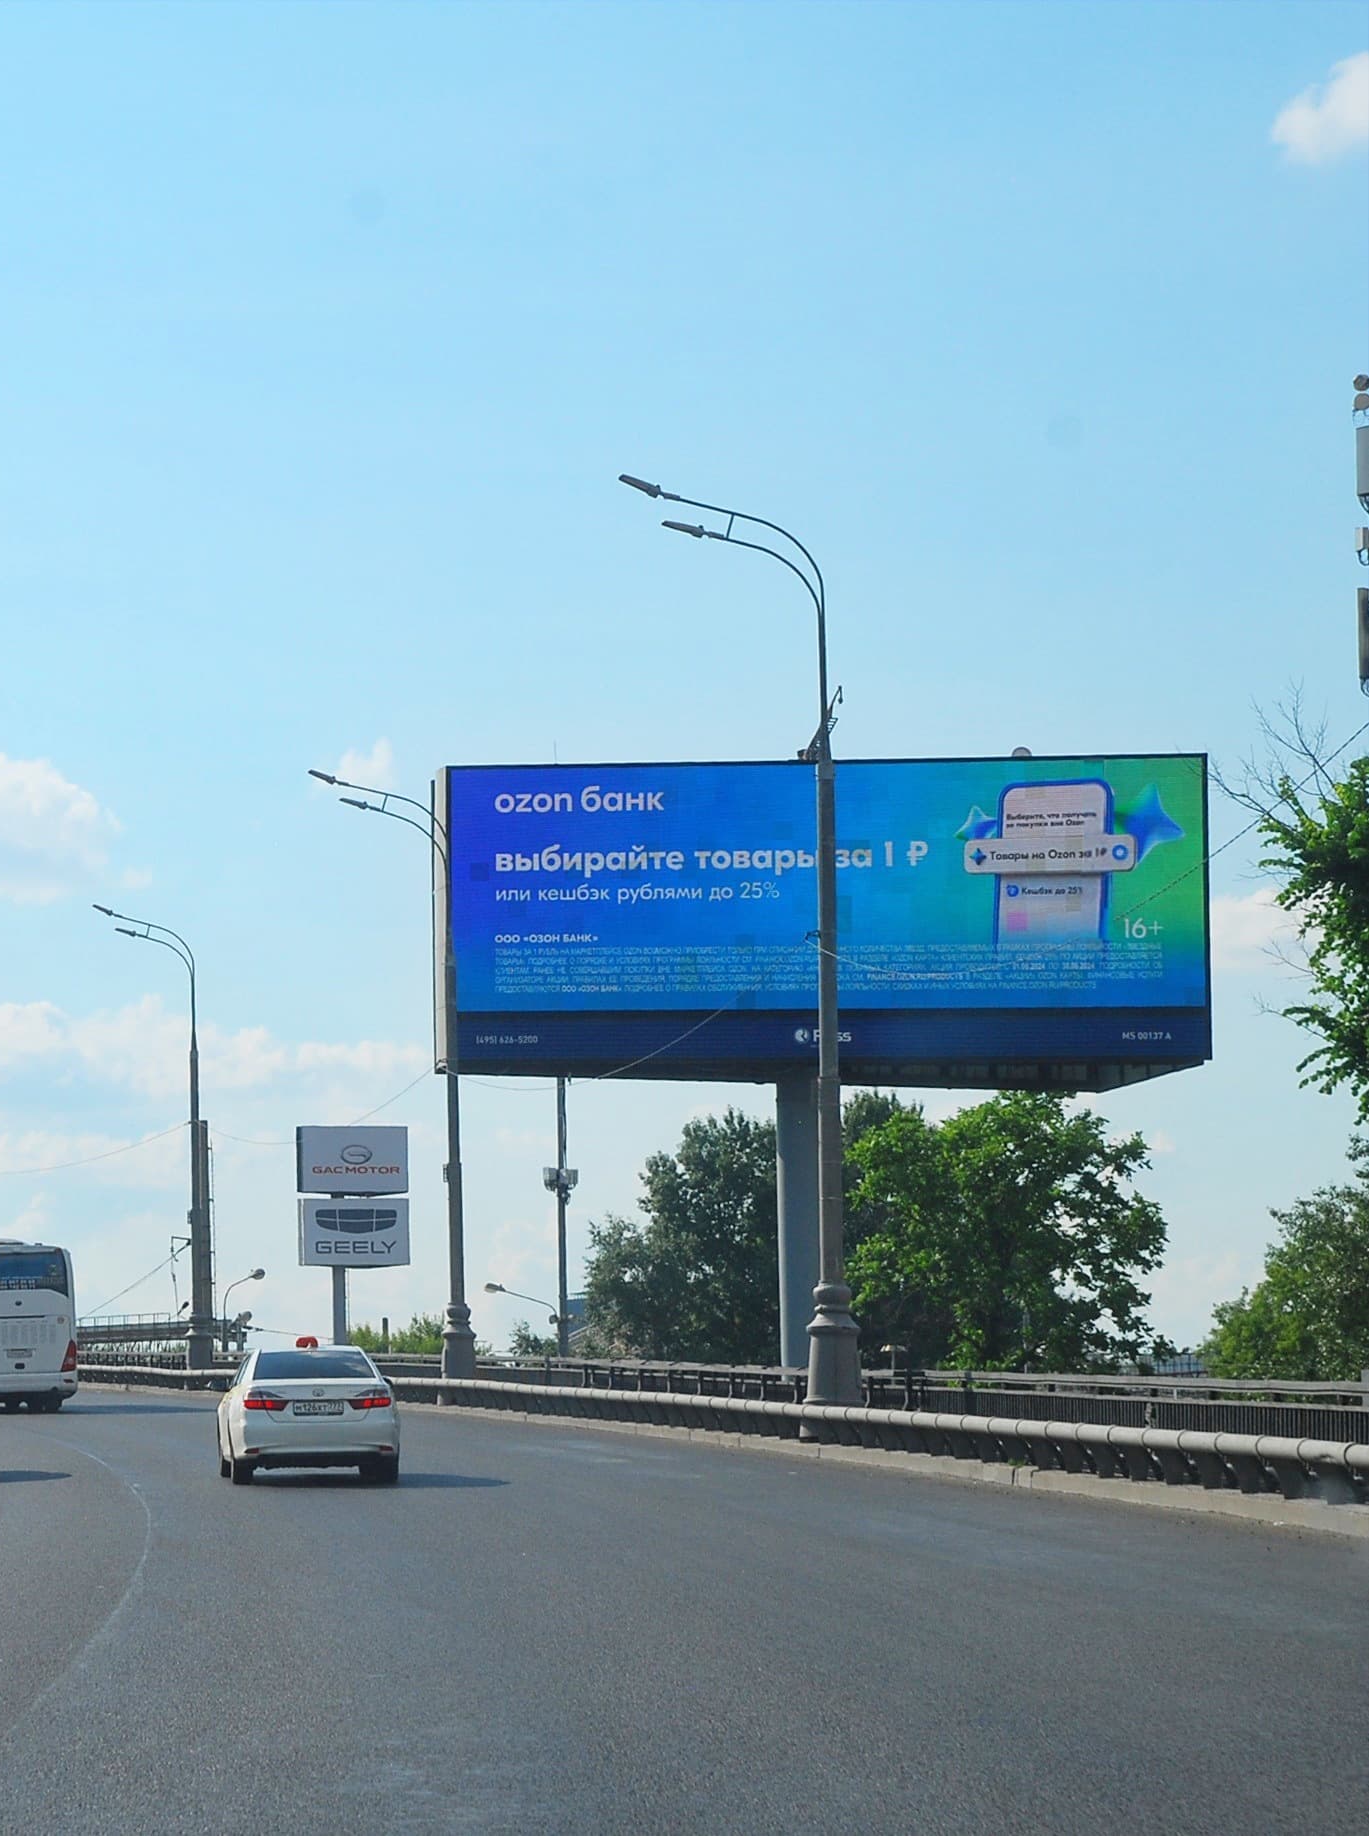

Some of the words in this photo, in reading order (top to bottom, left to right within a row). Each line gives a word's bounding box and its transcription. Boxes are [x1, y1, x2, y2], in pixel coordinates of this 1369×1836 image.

[494, 793, 573, 813] ozon
[580, 785, 664, 812] банк
[495, 844, 684, 878] выбирайте
[694, 849, 821, 876] товары
[835, 849, 873, 868] за
[885, 841, 893, 867] 1
[990, 851, 1029, 862] Товары
[1048, 849, 1076, 859] Ozon
[495, 889, 531, 901] или
[538, 884, 610, 900] кешбэк
[617, 884, 702, 904] рублями
[709, 887, 733, 902] до
[739, 882, 780, 899] 25%
[1124, 918, 1164, 939] 16+
[494, 934, 521, 943] ООО
[312, 1166, 343, 1174] GAC
[345, 1166, 400, 1174] MOTOR
[315, 1241, 396, 1254] GEELY
